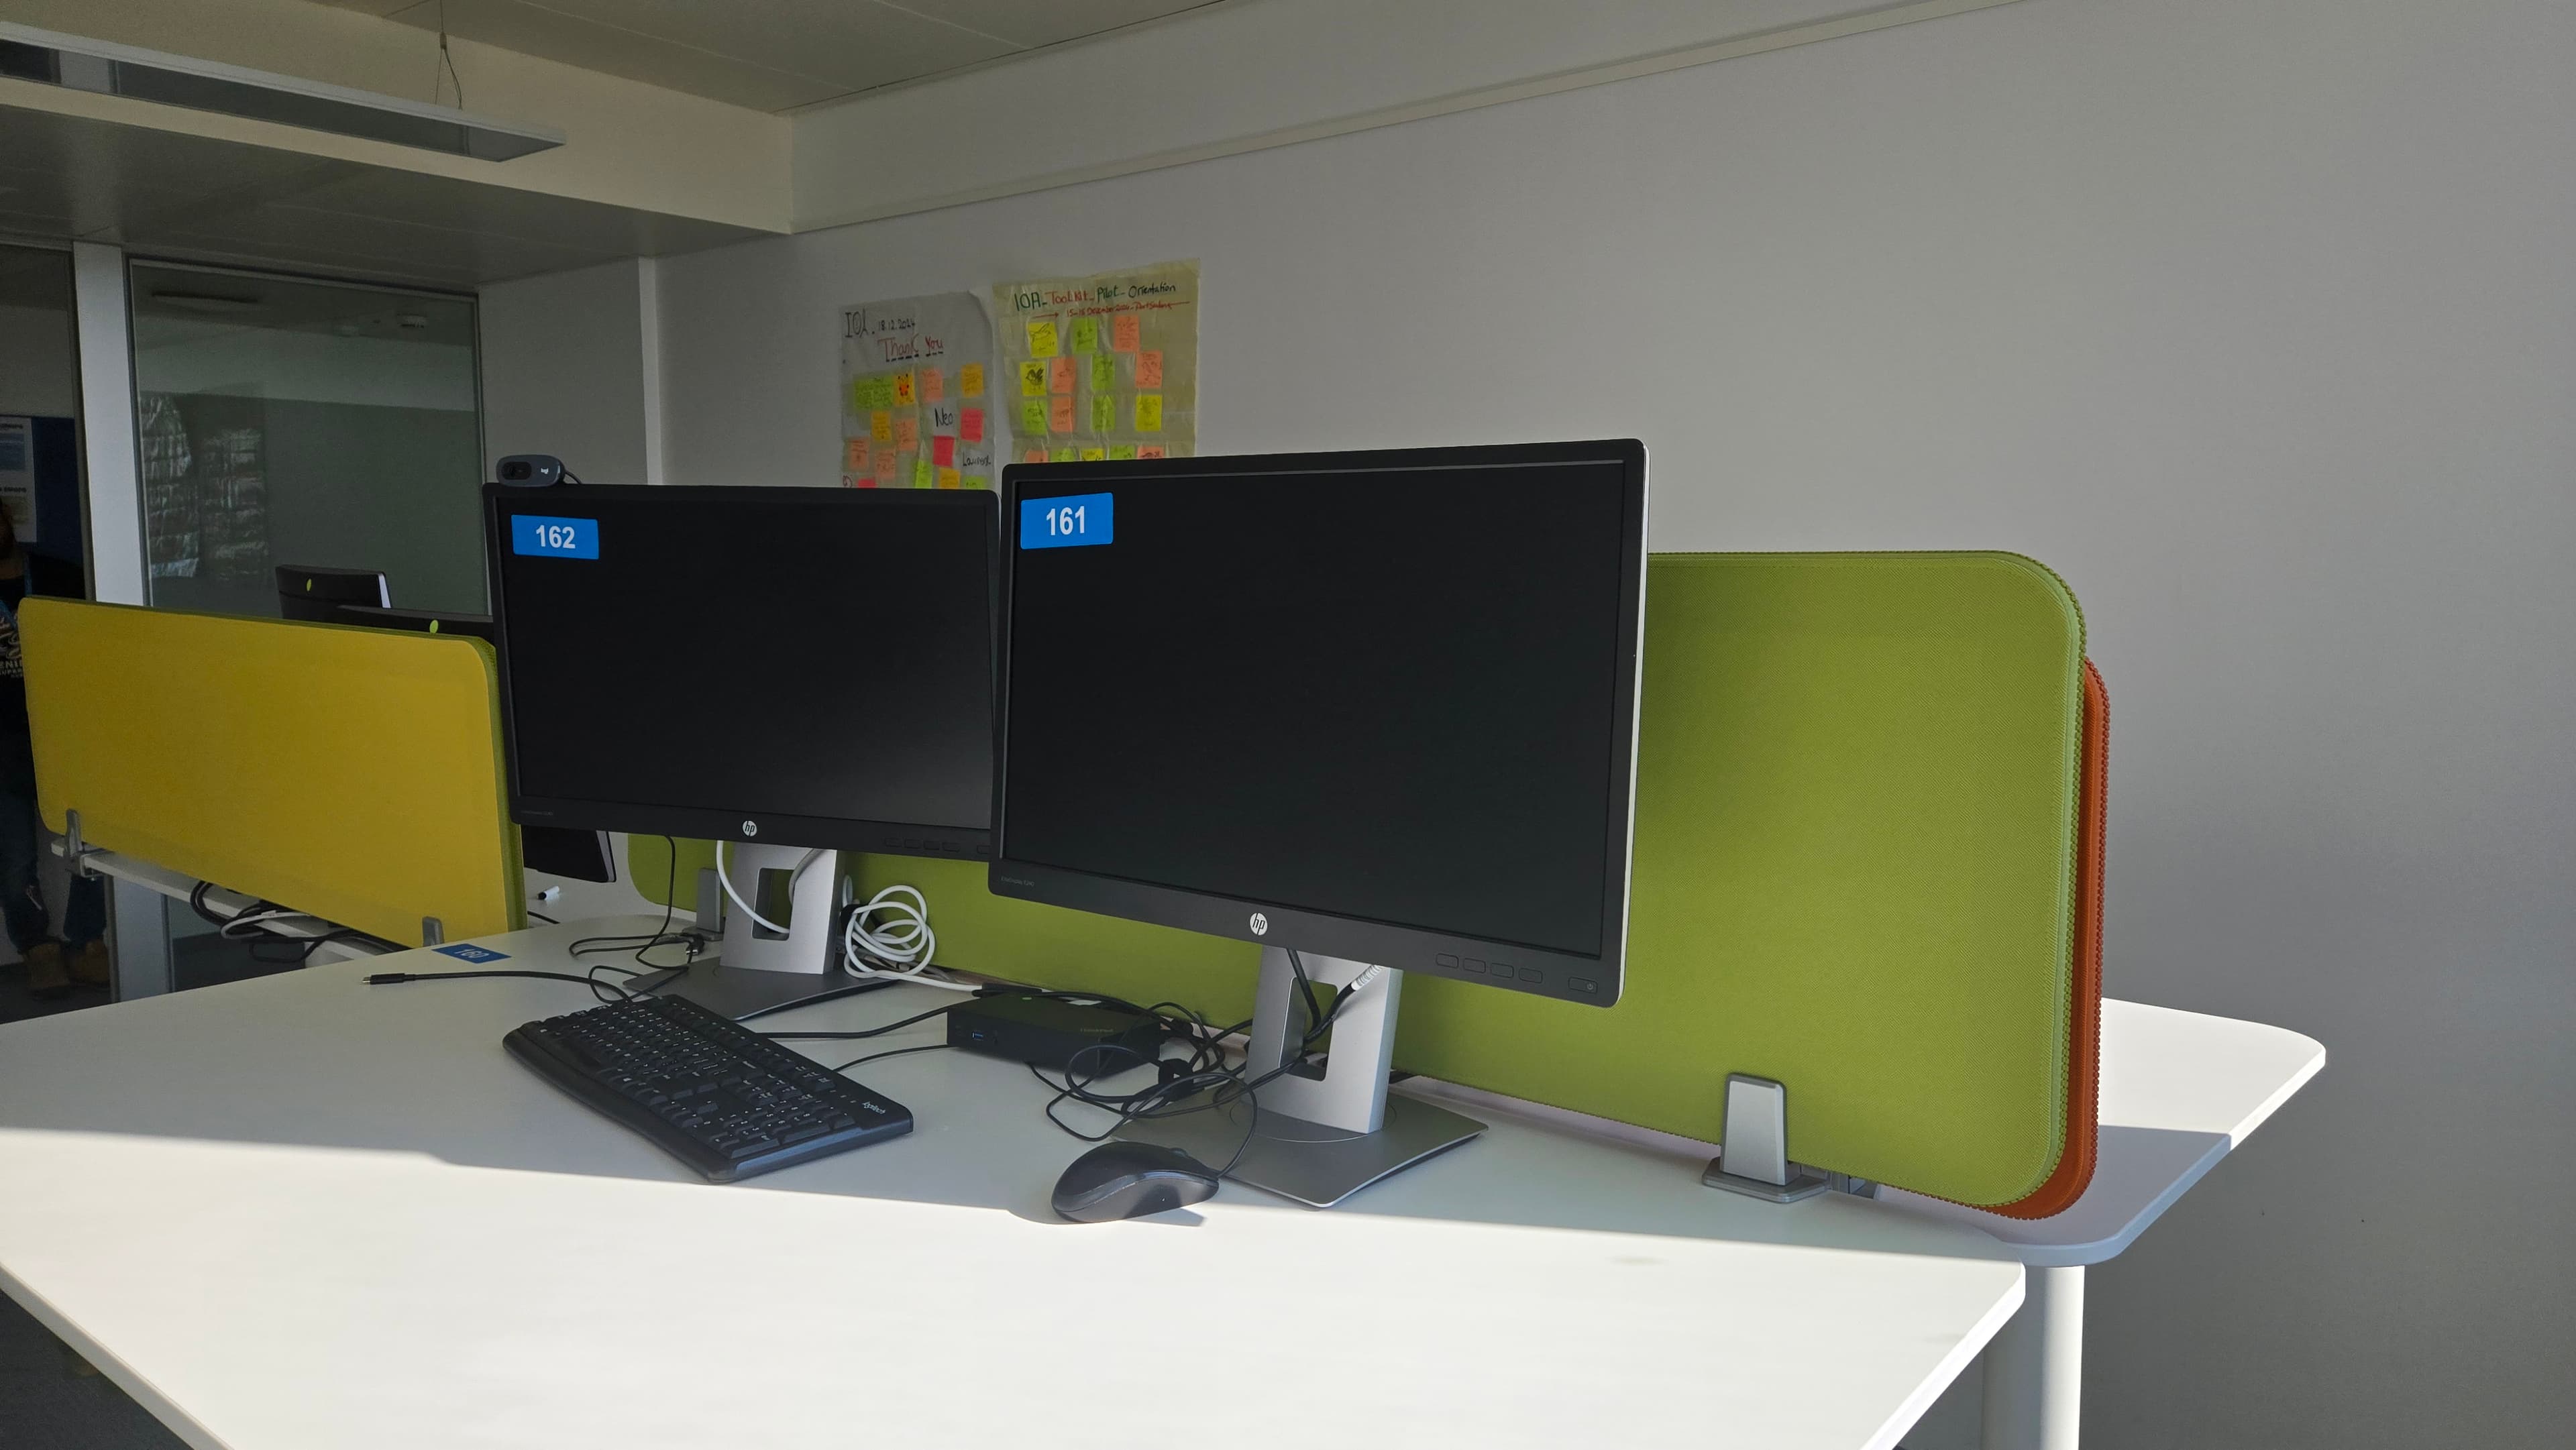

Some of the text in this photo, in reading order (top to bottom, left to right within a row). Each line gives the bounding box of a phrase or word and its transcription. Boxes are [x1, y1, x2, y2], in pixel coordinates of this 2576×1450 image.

[1128, 281, 1177, 298] Orientation
[924, 336, 944, 354] You
[934, 407, 953, 427] Neo
[1046, 505, 1085, 536] 161
[535, 524, 576, 549] 162
[743, 820, 756, 837] hp
[1251, 912, 1267, 936] hp
[454, 948, 490, 958] 160
